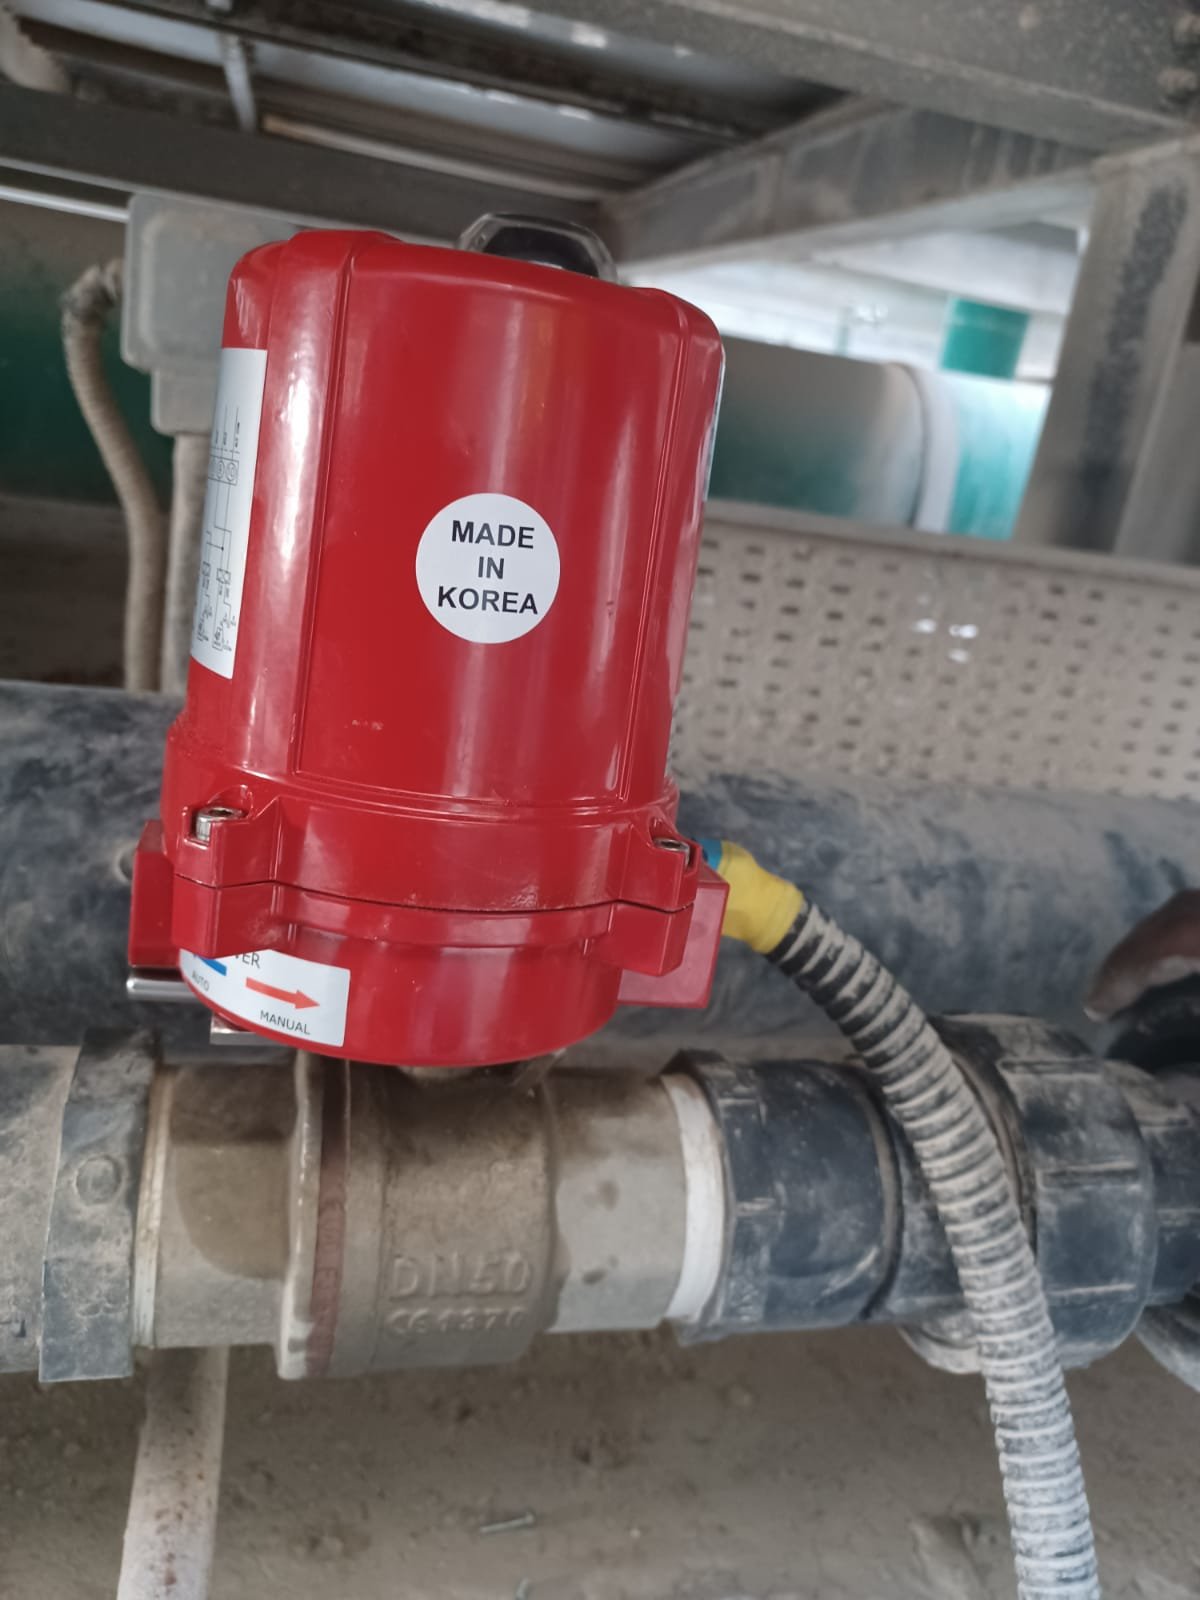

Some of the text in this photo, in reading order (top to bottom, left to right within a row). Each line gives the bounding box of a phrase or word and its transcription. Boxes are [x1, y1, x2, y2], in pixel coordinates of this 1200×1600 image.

[451, 519, 535, 549] MADE
[477, 556, 505, 580] IN
[437, 585, 538, 615] KOREA
[191, 970, 210, 992] AUTO
[260, 1010, 311, 1036] MANUAL
